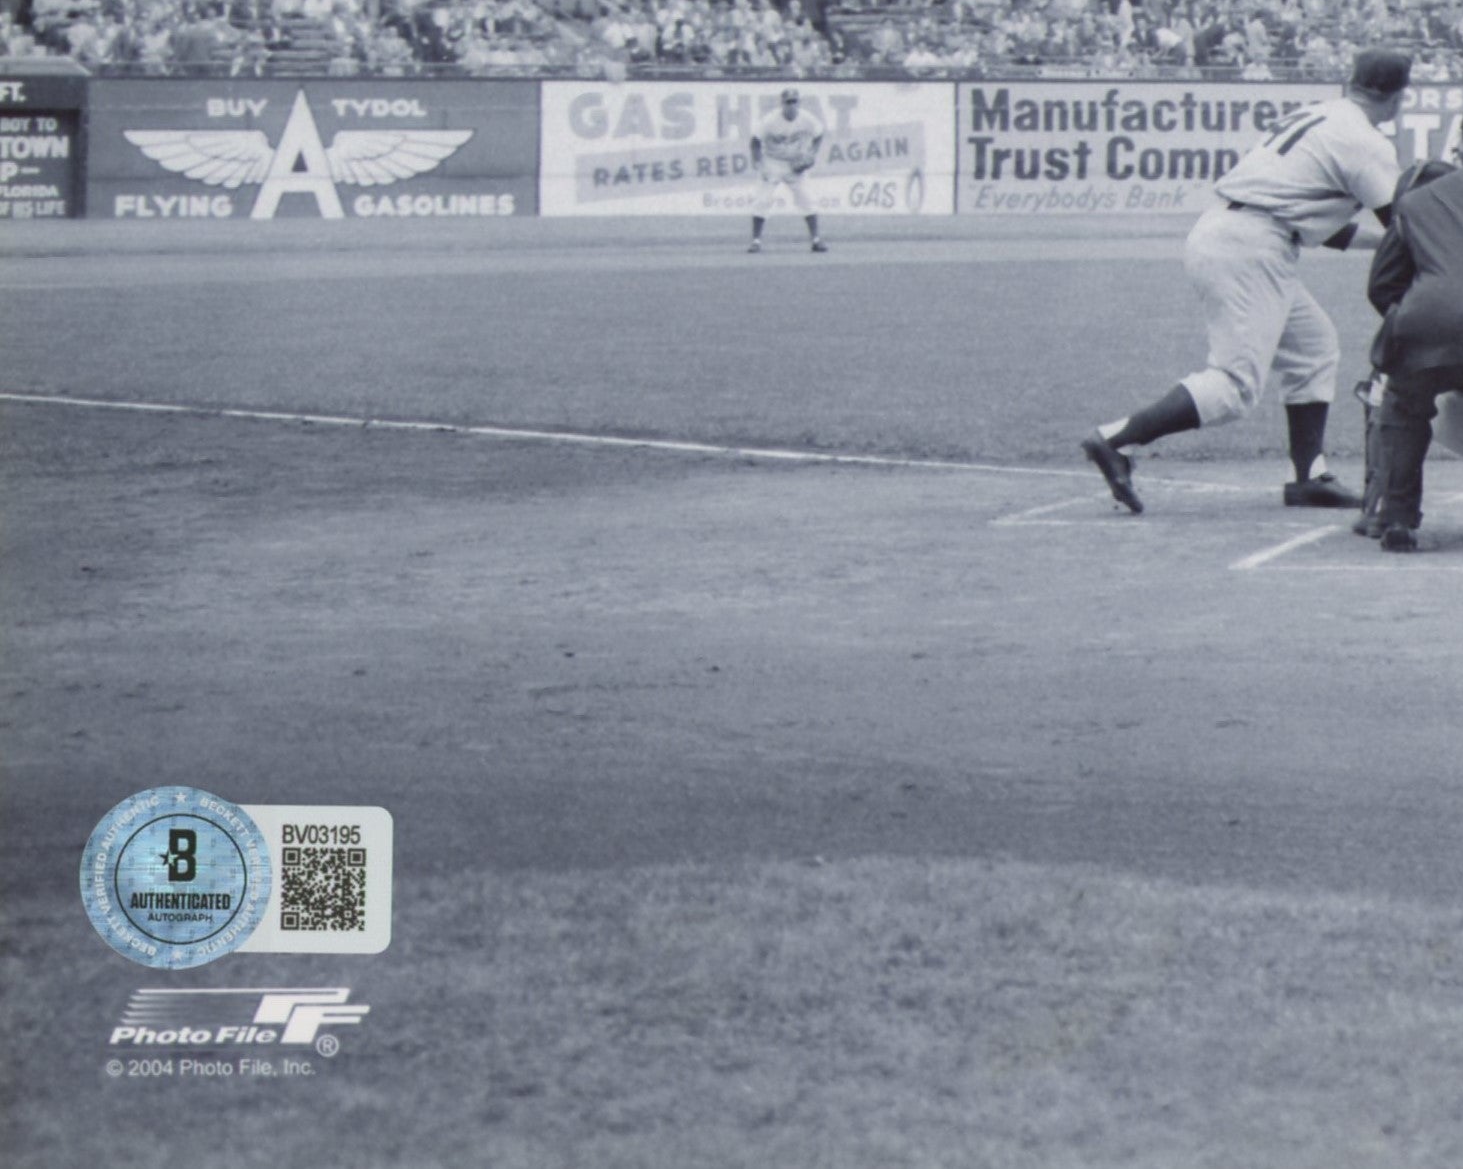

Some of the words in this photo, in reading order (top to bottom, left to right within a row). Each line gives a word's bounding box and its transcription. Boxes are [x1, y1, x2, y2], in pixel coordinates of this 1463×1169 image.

[207, 99, 268, 118] BUY
[332, 99, 428, 118] TYDOL
[568, 92, 697, 140] GAS
[970, 88, 1322, 132] Manufacturer
[115, 195, 234, 217] FLYING
[250, 89, 345, 219] A
[353, 194, 516, 217] GASOLINES
[593, 159, 685, 187] RATES
[827, 136, 910, 164] AGAIN
[968, 137, 1093, 181] Trust
[1105, 136, 1242, 183] Comp
[850, 181, 897, 209] GAS
[168, 828, 197, 883] B
[282, 824, 361, 845] BV03195
[130, 892, 231, 911] AUTHENTICATED
[147, 912, 213, 923] AUTOGRAPH
